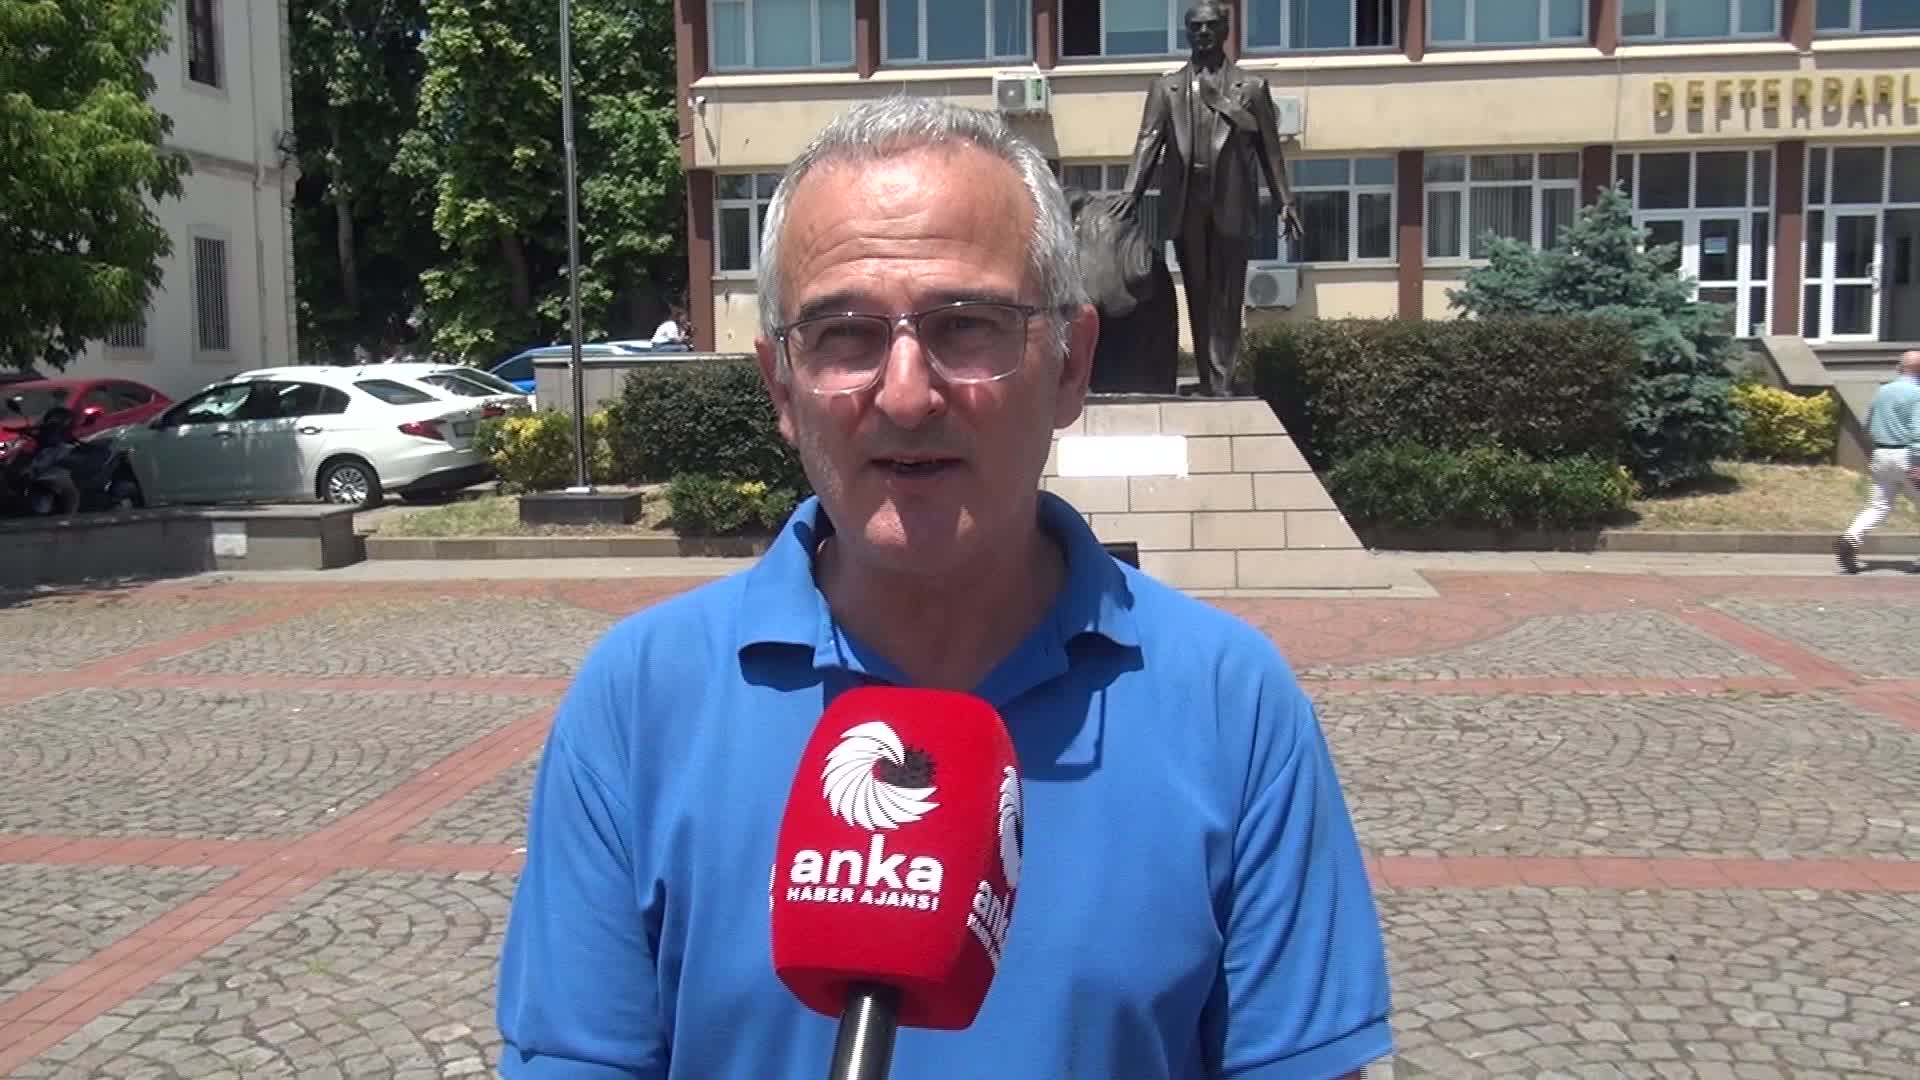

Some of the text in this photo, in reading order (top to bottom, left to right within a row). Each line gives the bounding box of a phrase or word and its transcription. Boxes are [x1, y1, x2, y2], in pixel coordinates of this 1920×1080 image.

[789, 833, 944, 893] anka
[786, 887, 940, 912] HABER AJANSI
